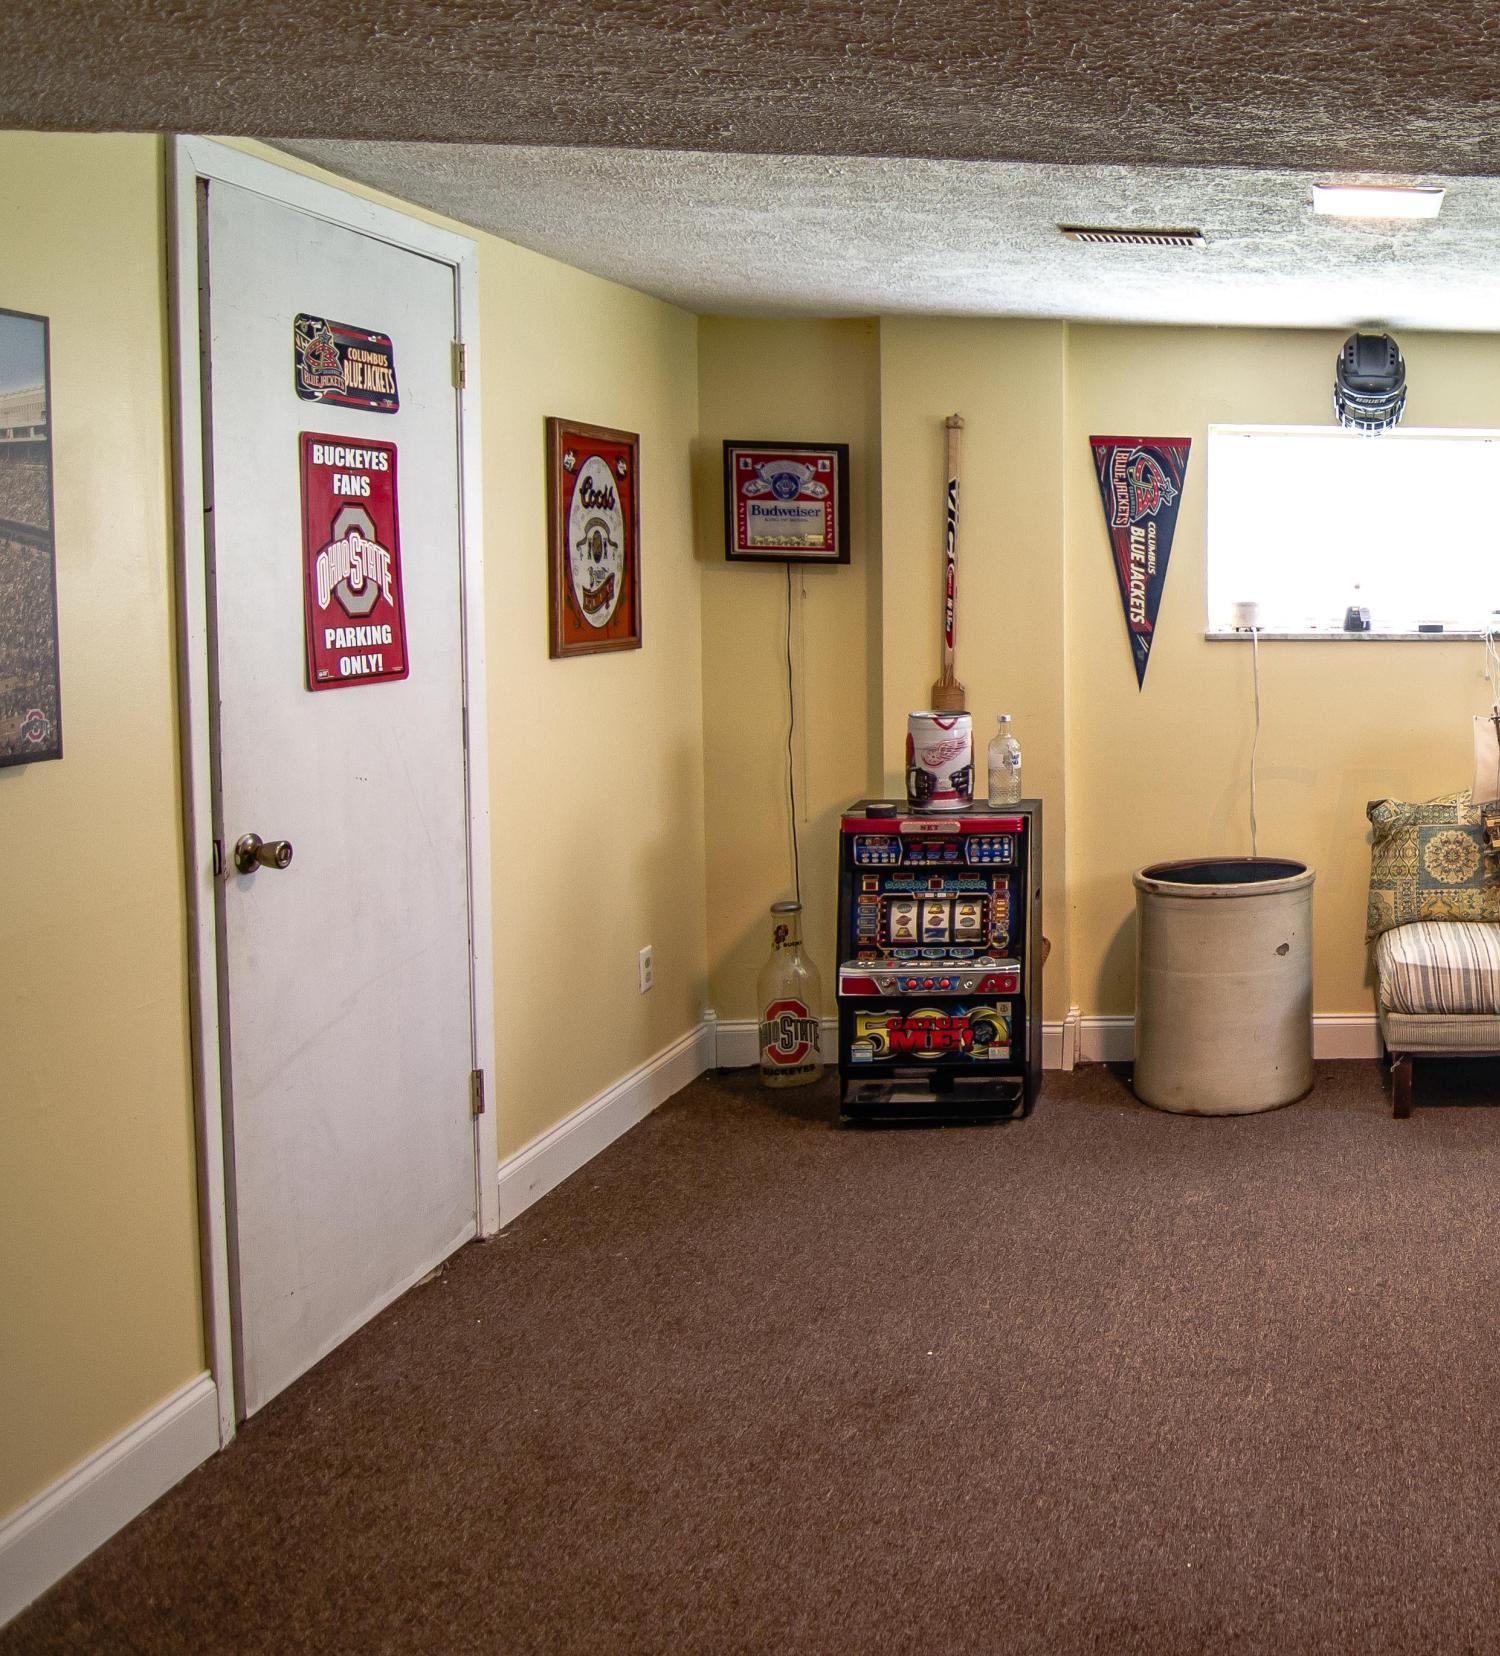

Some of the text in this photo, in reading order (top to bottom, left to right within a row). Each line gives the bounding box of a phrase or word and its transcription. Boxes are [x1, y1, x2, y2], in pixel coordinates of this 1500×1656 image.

[348, 348, 388, 367] COLUMBUS
[344, 360, 396, 395] BLUE JACKETS
[313, 444, 389, 471] BUCKEYES
[333, 473, 371, 497] FANS
[1113, 452, 1130, 524] BLUE JACKETS
[751, 504, 821, 518] Budweiser
[1148, 521, 1157, 575] COLUMBUS
[316, 532, 394, 610] OHIO STATE
[1130, 526, 1146, 625] BLUE JACKETS
[325, 624, 393, 649] PARKING
[340, 653, 384, 677] ONLY!
[886, 1016, 971, 1031] CATCH
[889, 1028, 975, 1054] ME!
[762, 1064, 816, 1077] BUCKEYES
